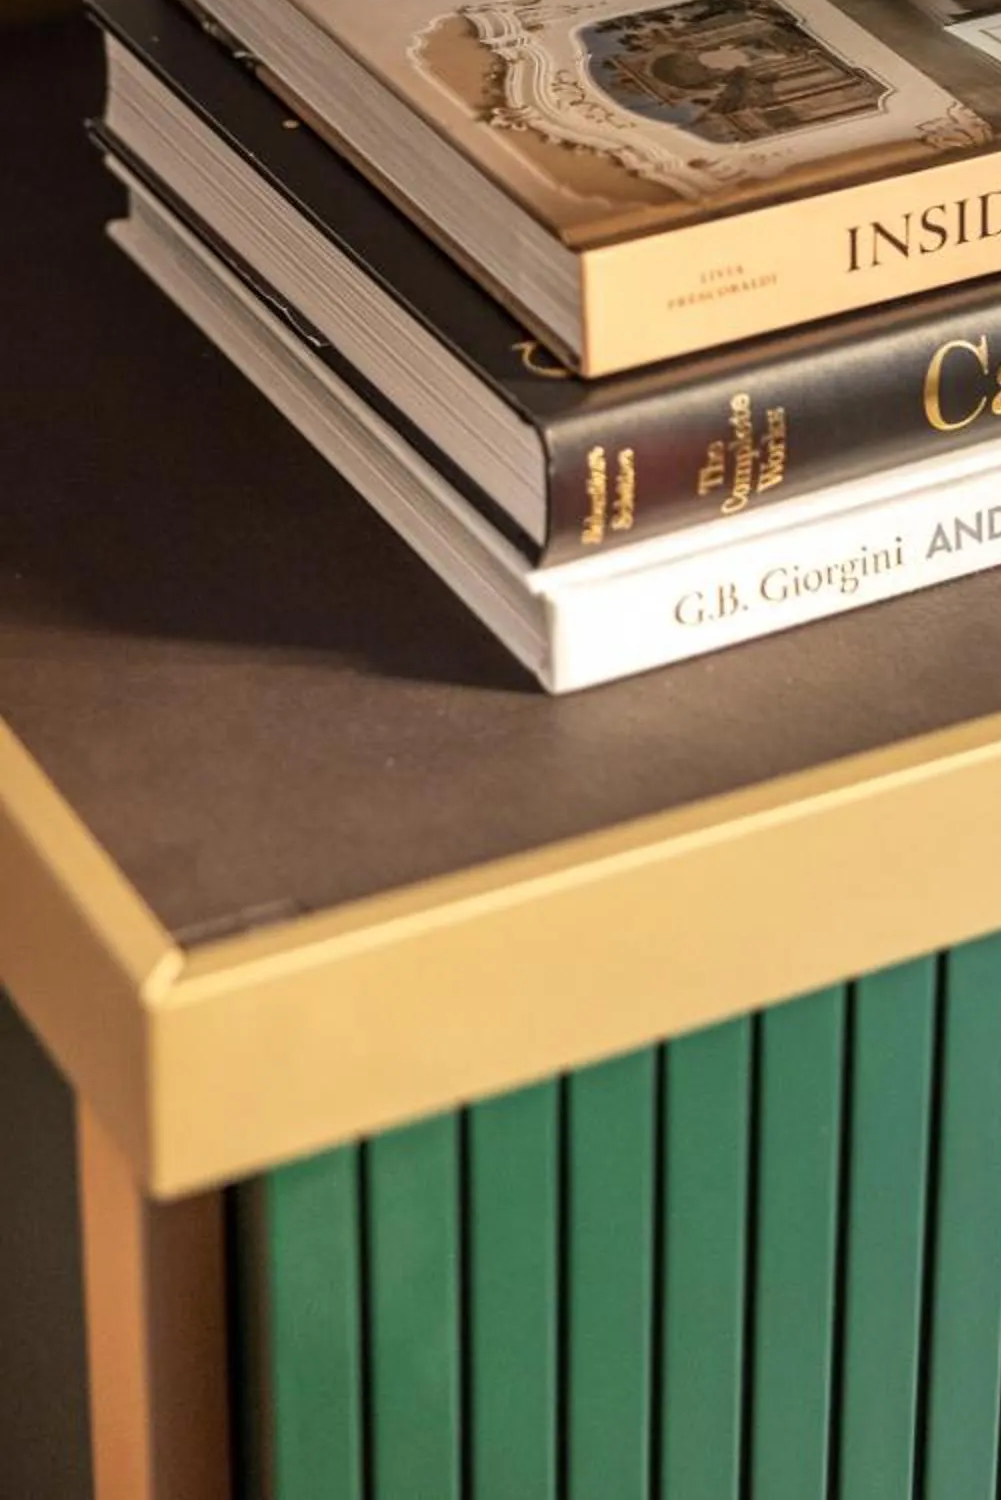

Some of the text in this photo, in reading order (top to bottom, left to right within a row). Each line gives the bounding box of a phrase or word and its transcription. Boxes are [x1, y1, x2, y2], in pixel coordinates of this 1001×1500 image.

[698, 441, 725, 495] The
[721, 393, 760, 514] Complete
[756, 406, 786, 494] Works
[672, 583, 749, 628] G.B.
[758, 536, 905, 600] Giorgini
